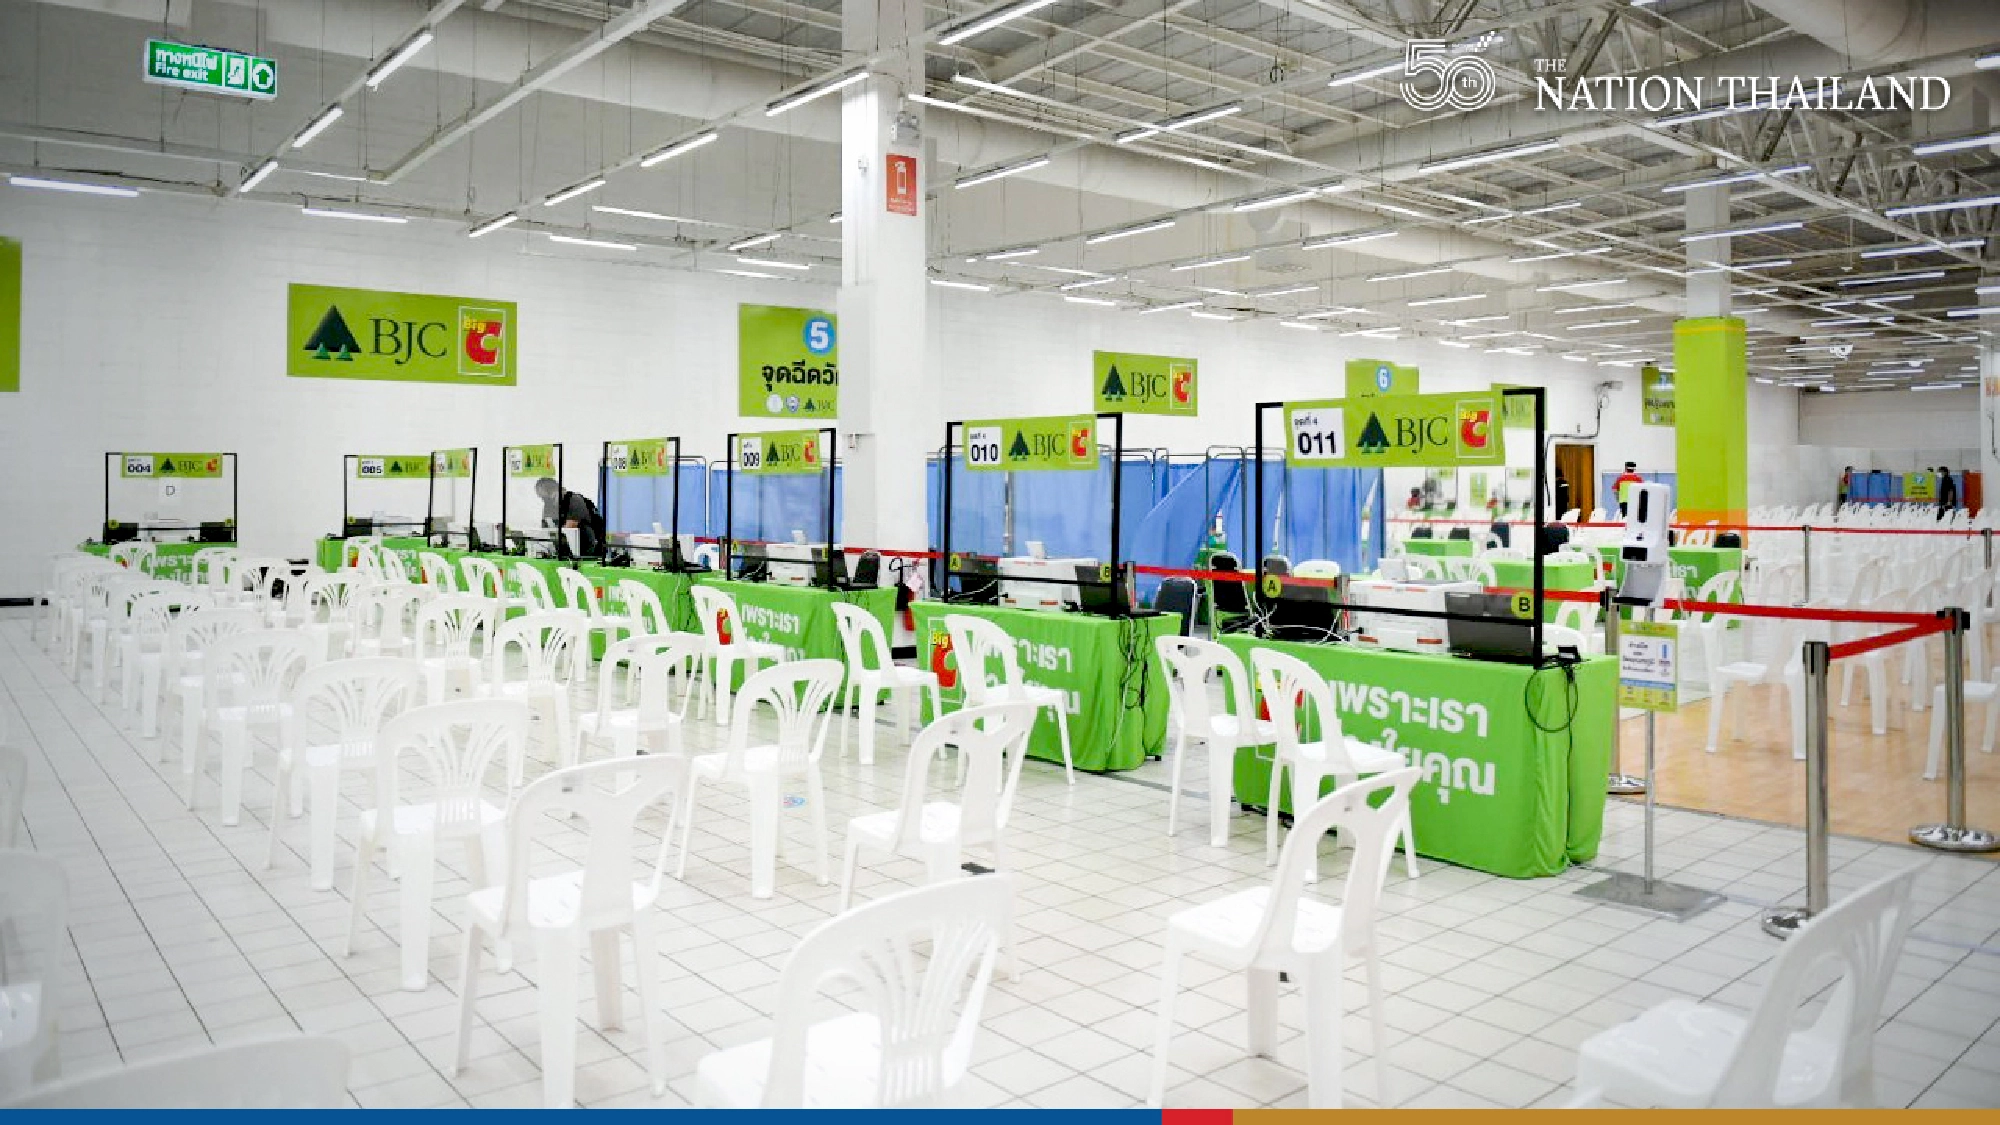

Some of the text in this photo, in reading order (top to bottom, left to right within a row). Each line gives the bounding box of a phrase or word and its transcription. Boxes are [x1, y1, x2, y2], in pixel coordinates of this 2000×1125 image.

[155, 61, 209, 82] Fire exit
[463, 316, 487, 334] Big
[810, 321, 830, 350] 5
[368, 318, 448, 365] BJC
[465, 320, 503, 365] C
[761, 359, 839, 392] จุดฉีดวั
[1378, 368, 1389, 388] 6
[1130, 371, 1168, 404] BJC
[1298, 430, 1337, 456] 011
[1395, 416, 1448, 453] BJC
[971, 443, 999, 462] 010
[1033, 433, 1065, 461] BJC
[743, 452, 761, 467] 009
[165, 485, 176, 496] D
[1267, 579, 1276, 592] A
[1518, 595, 1530, 612] B
